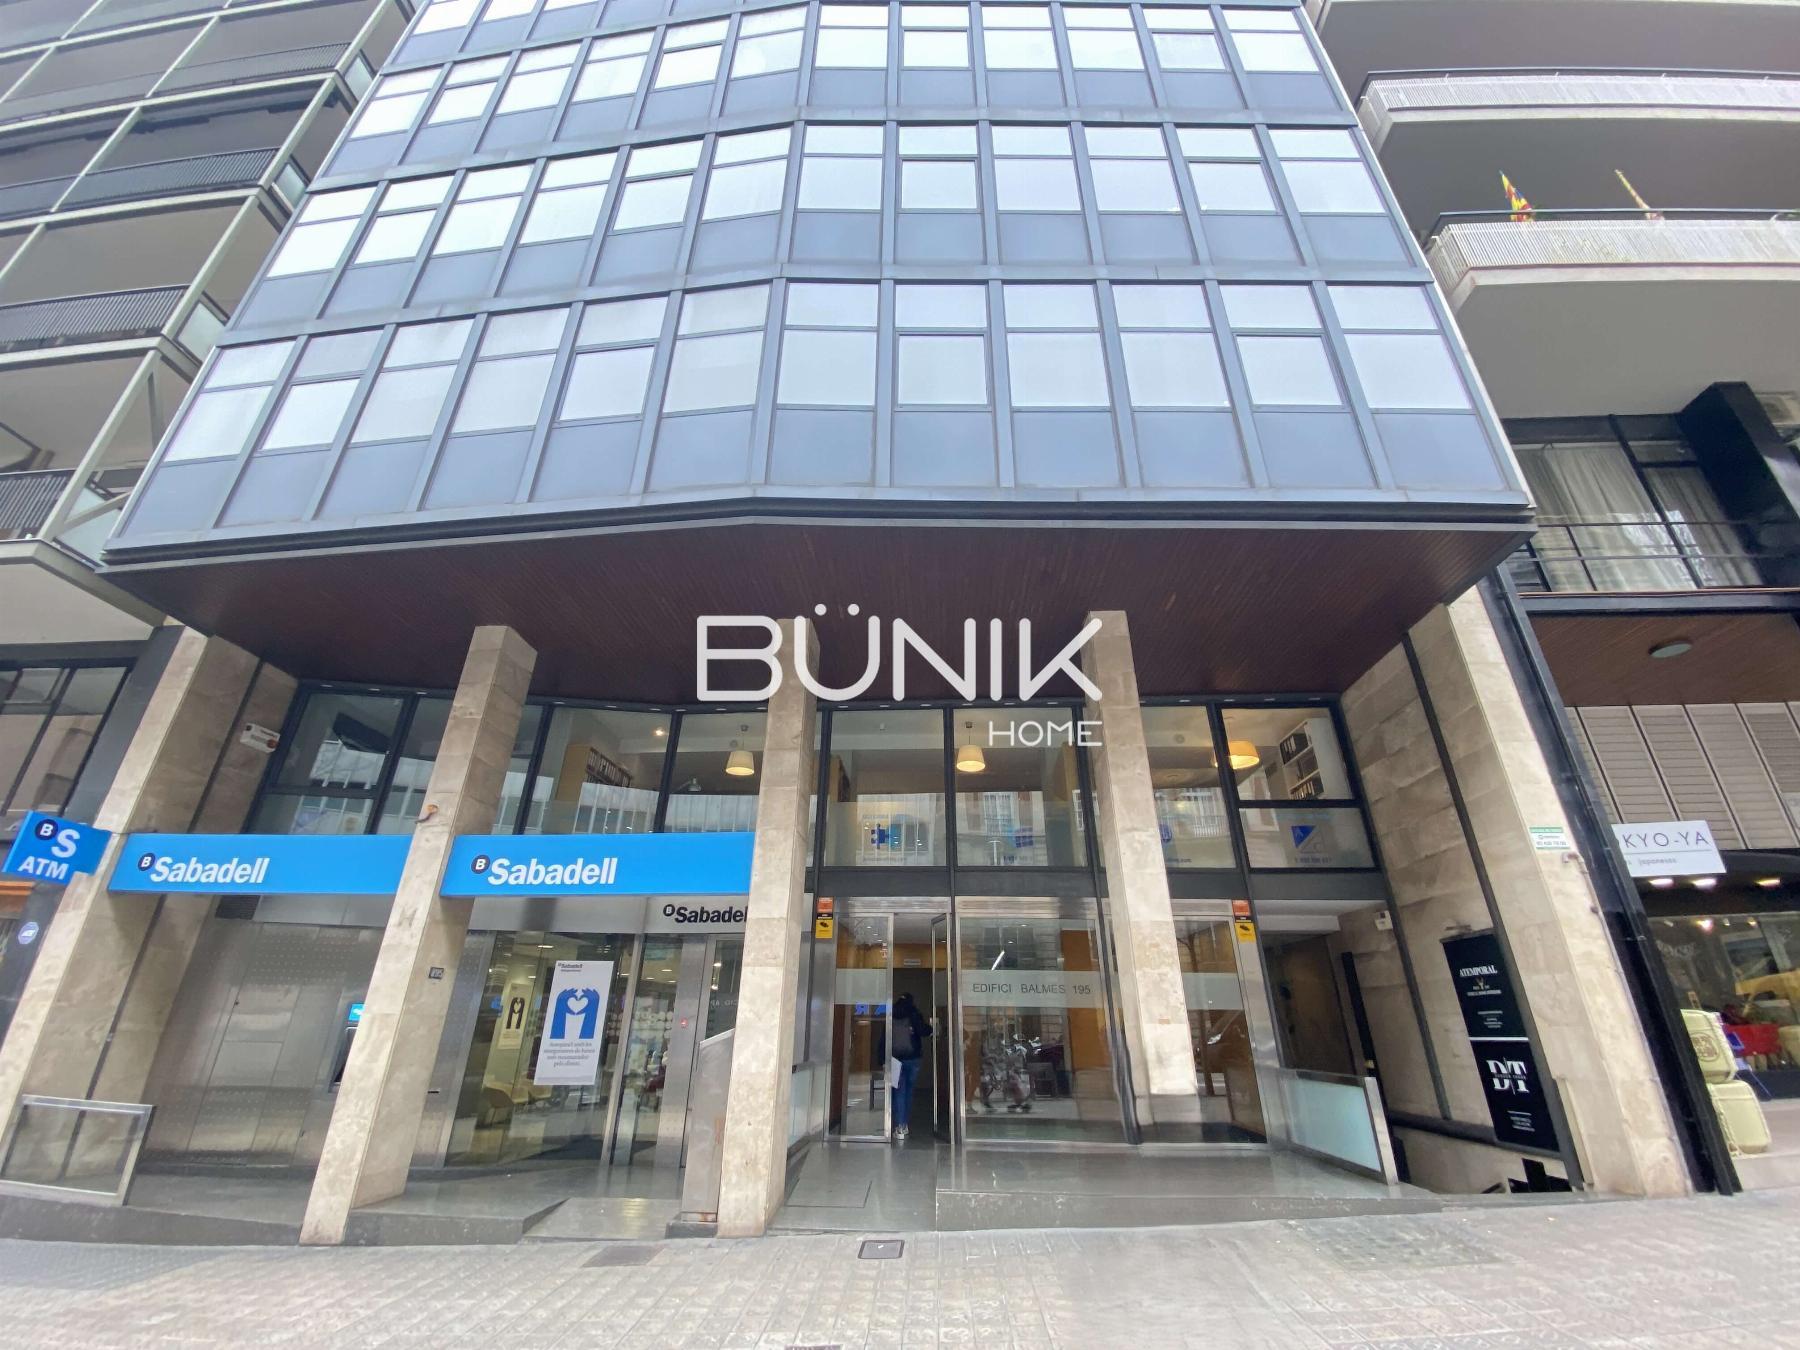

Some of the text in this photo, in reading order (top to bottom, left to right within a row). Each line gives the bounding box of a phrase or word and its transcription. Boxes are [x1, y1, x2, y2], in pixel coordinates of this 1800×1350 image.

[40, 823, 81, 858] B S
[1622, 831, 1711, 848] KYO-YA
[18, 855, 69, 880] ATM
[141, 856, 270, 884] B Sabadell
[475, 857, 618, 885] B Sabadell
[1460, 965, 1498, 977] ATEMPORAL
[973, 983, 1091, 995] EDIFICI BALMES 195
